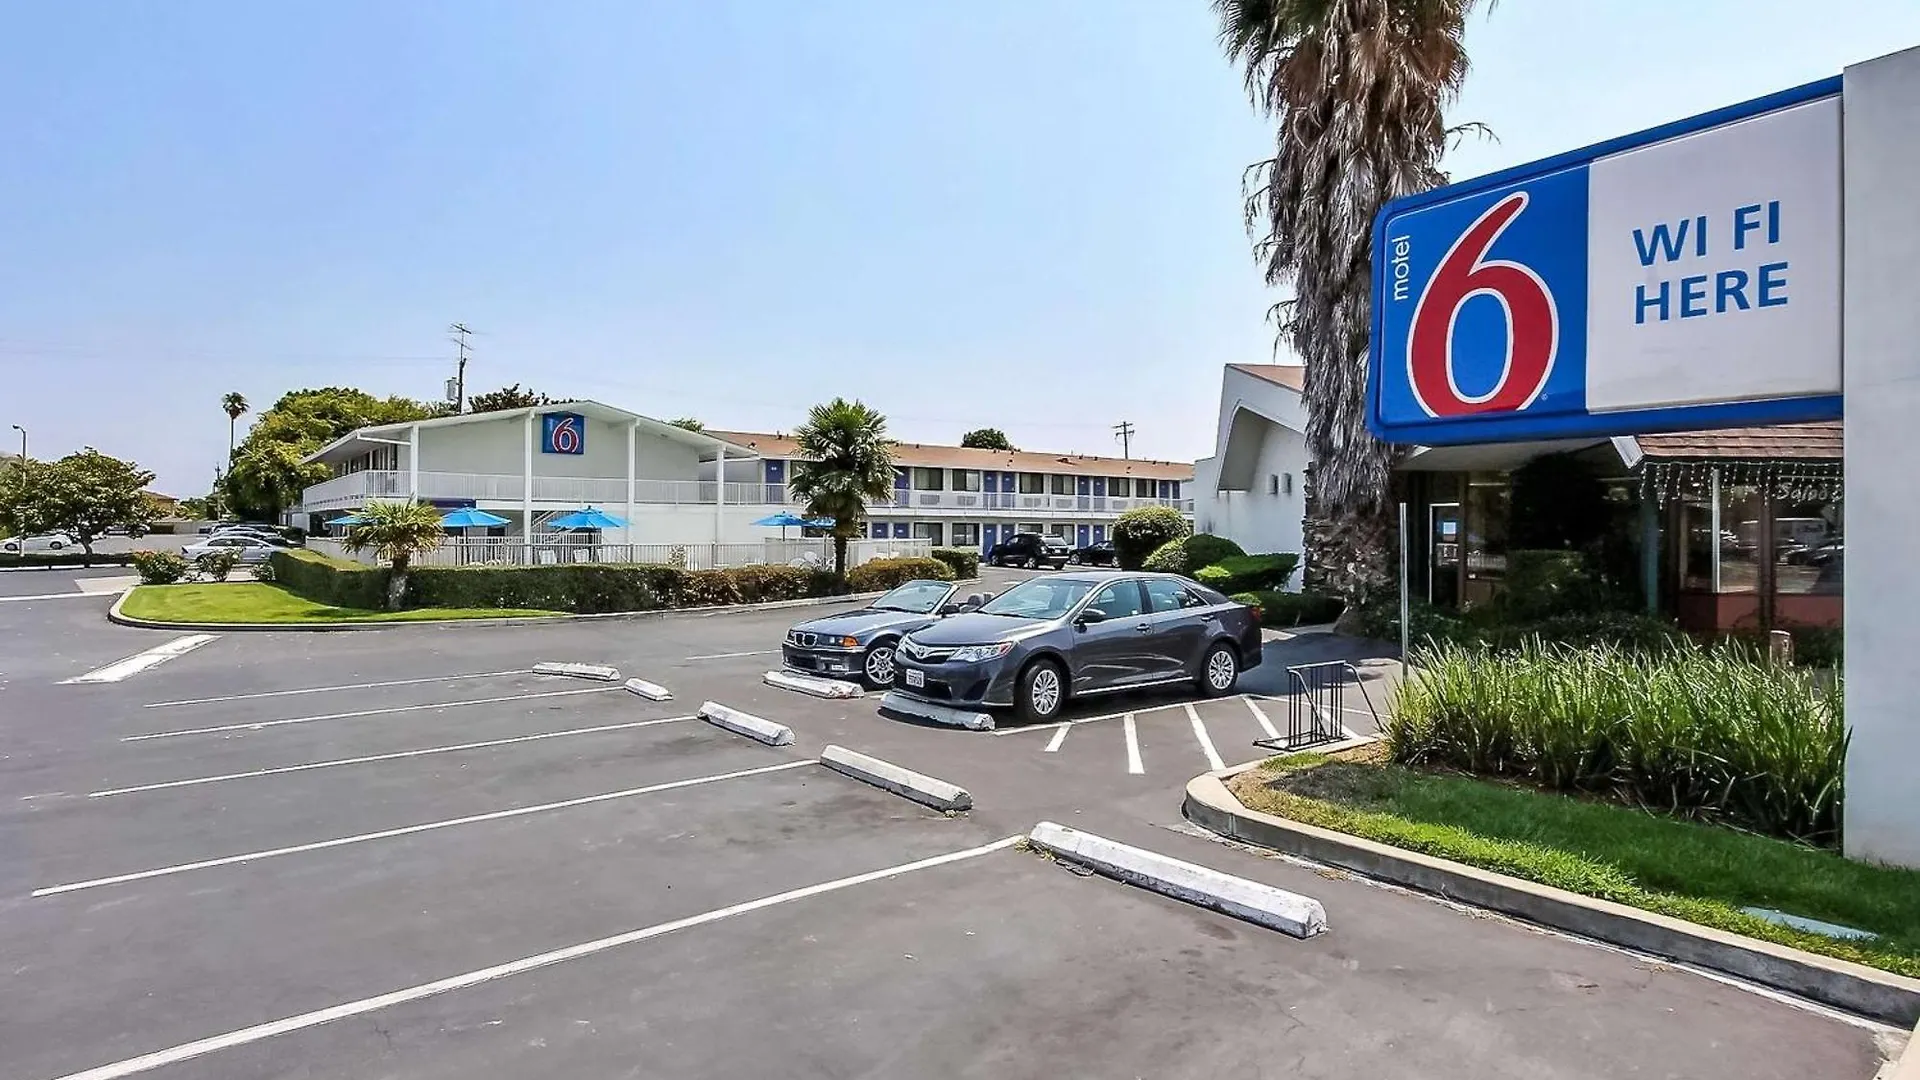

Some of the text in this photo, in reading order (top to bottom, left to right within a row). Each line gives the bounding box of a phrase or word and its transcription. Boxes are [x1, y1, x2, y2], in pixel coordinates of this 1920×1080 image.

[1633, 200, 1781, 267] WI FI
[1391, 235, 1410, 300] motel
[1635, 263, 1789, 325] HERE
[1407, 191, 1559, 418] 6
[552, 417, 579, 453] 6
